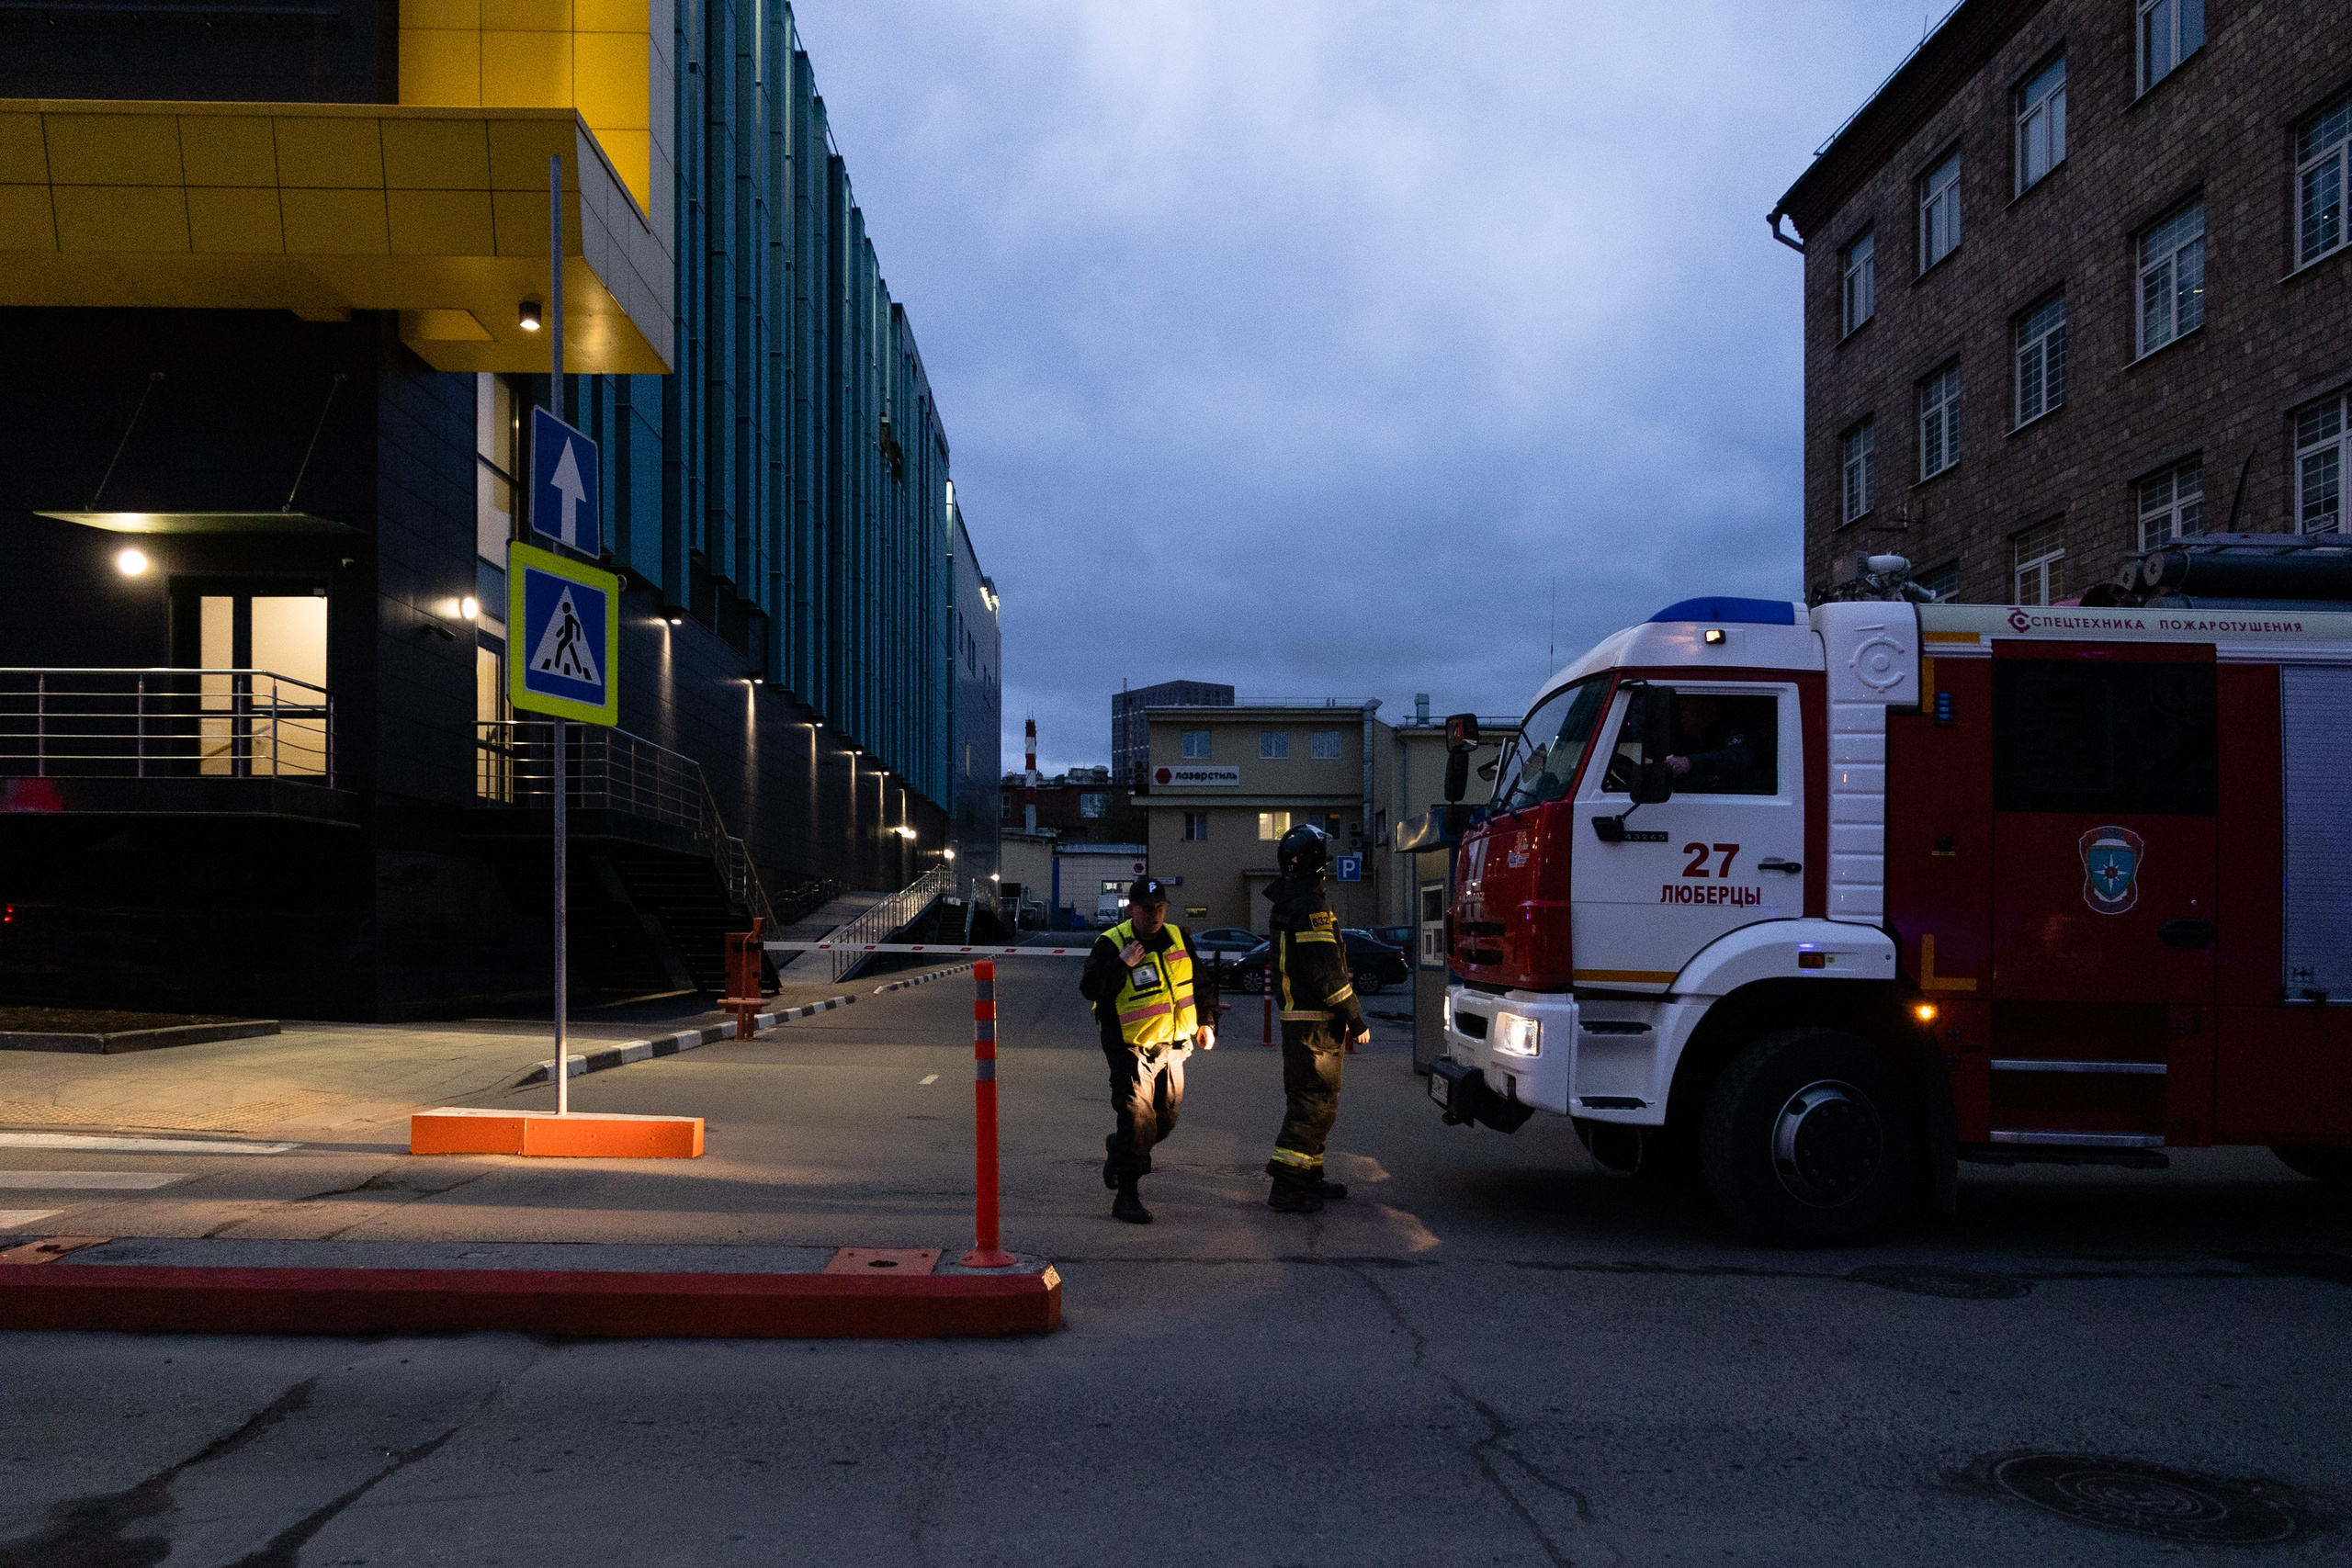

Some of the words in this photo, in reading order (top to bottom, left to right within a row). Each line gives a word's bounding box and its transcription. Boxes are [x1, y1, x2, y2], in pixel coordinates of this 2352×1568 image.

[2030, 616, 2145, 630] СПЕЦТЕХНИКА
[2159, 619, 2303, 633] ПОЖАРОТУШЕНИЯ
[1175, 772, 1238, 782] лазерстиль
[1624, 832, 1667, 841] 43265
[1682, 842, 1740, 878] 27
[1342, 859, 1356, 879] P
[1660, 885, 1761, 908] ЛЮБЕРЦЫ
[1312, 916, 1329, 928] 632
